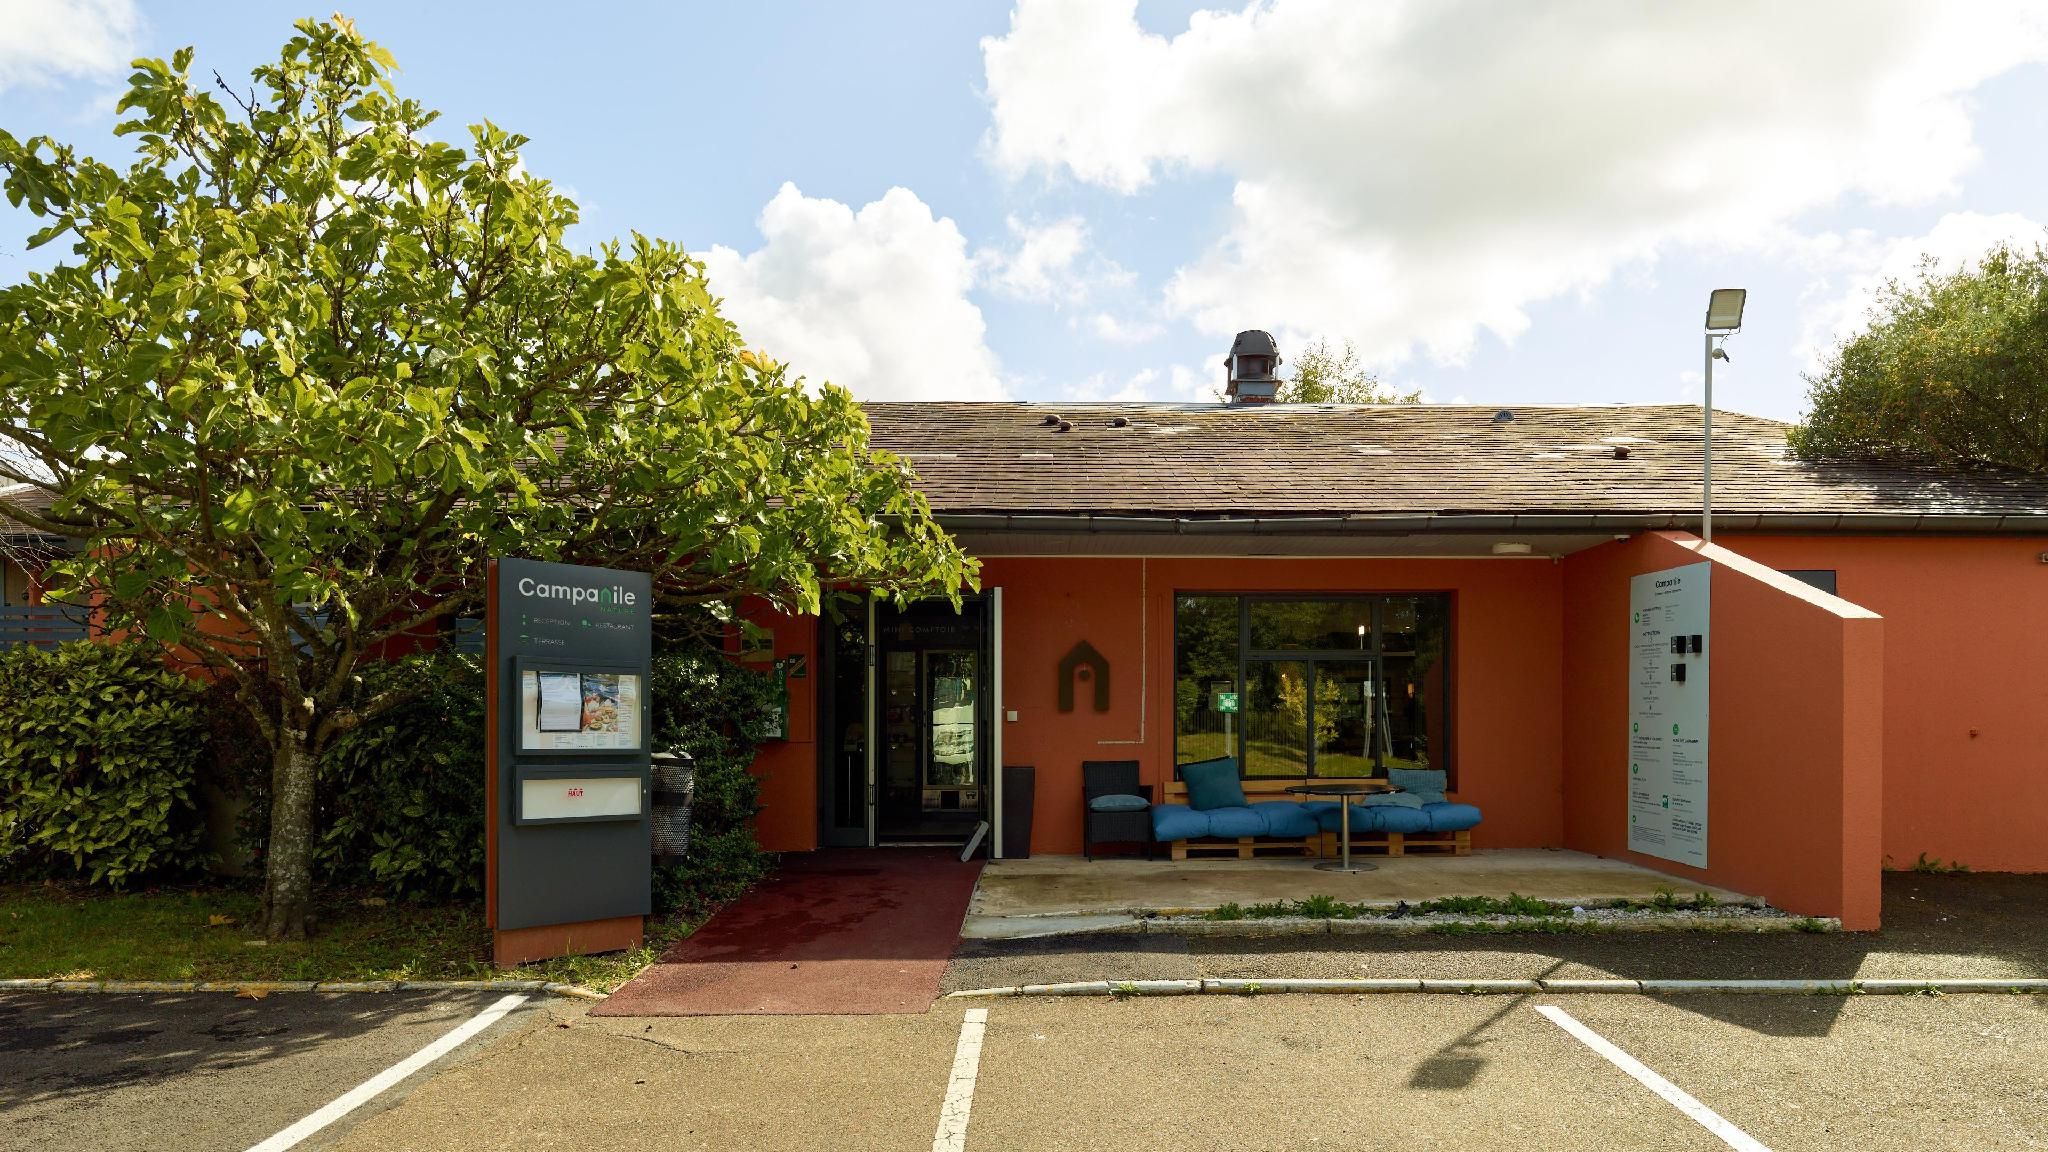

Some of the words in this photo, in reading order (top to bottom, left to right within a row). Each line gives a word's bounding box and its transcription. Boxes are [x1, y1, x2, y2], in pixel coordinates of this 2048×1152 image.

[518, 577, 636, 606] Campanile
[595, 622, 635, 631] RESTAURANT
[532, 637, 565, 646] TERRASSE
